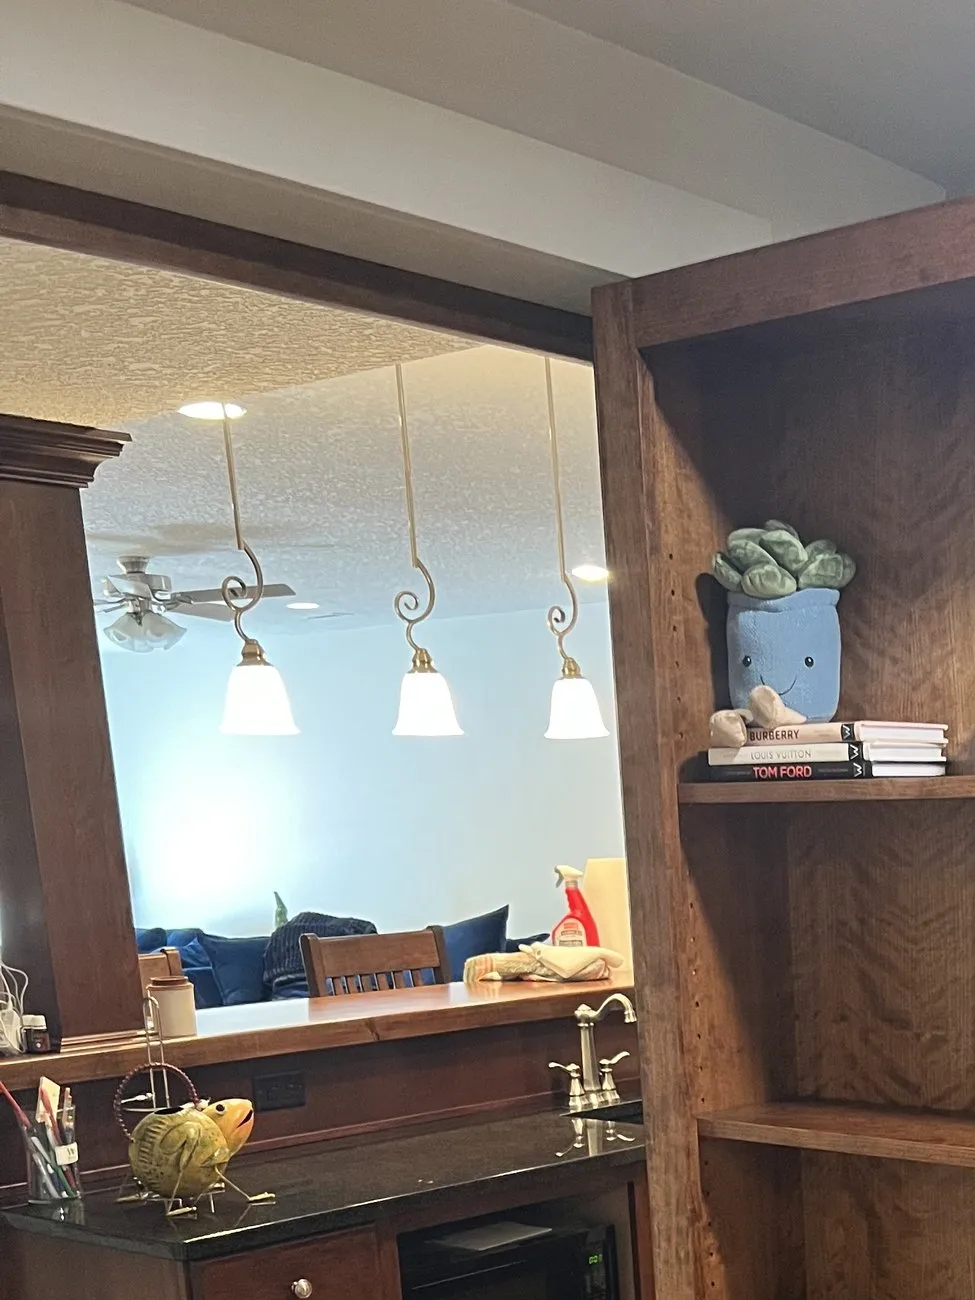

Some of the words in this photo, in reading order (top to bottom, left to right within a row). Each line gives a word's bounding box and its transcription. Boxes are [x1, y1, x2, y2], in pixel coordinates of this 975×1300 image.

[749, 729, 800, 741] BURBERRY
[750, 751, 773, 760] LOUIS
[775, 749, 812, 760] VUITTON
[753, 766, 777, 779] TOM
[780, 765, 812, 778] FORD
